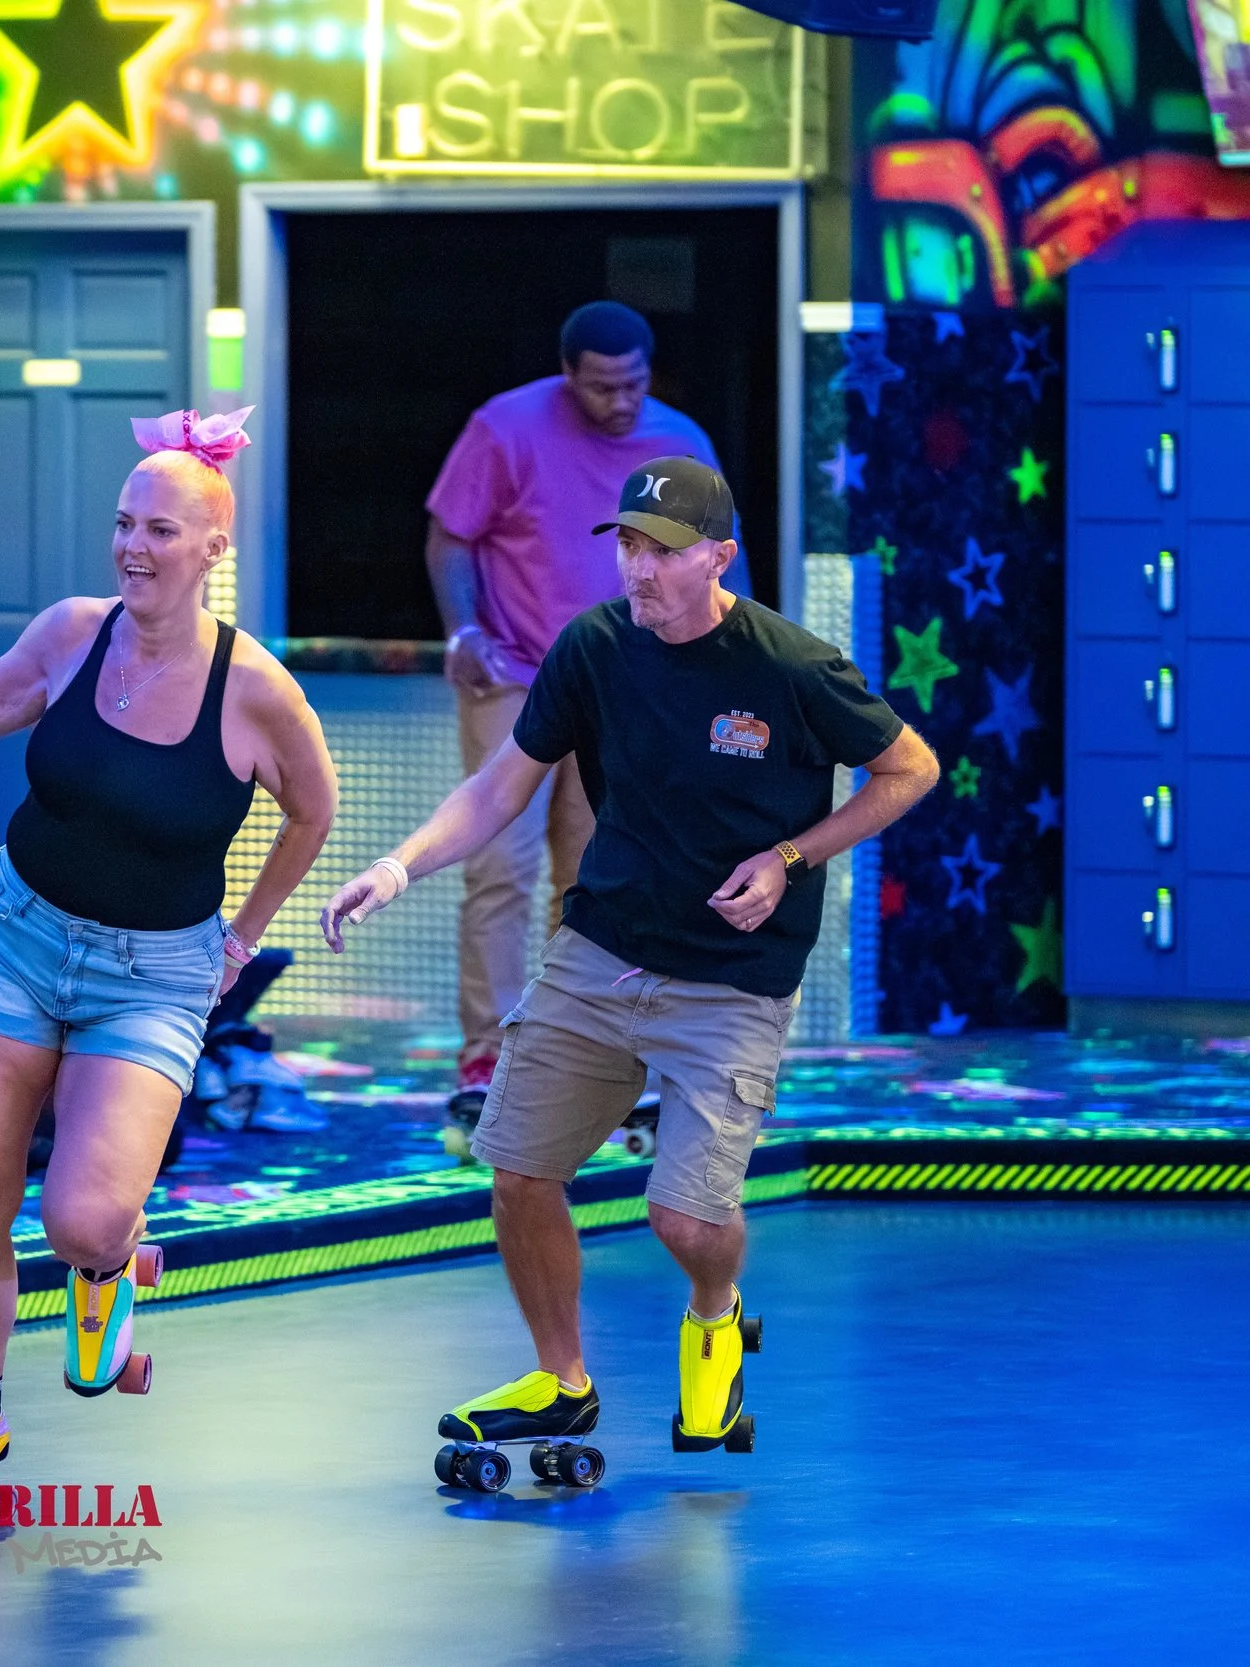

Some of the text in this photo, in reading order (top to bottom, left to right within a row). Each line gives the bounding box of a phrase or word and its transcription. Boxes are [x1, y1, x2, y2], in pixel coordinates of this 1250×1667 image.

[427, 70, 751, 160] SHOP
[710, 743, 765, 759] WE CAME TO ROLL
[704, 1332, 712, 1357] BONT
